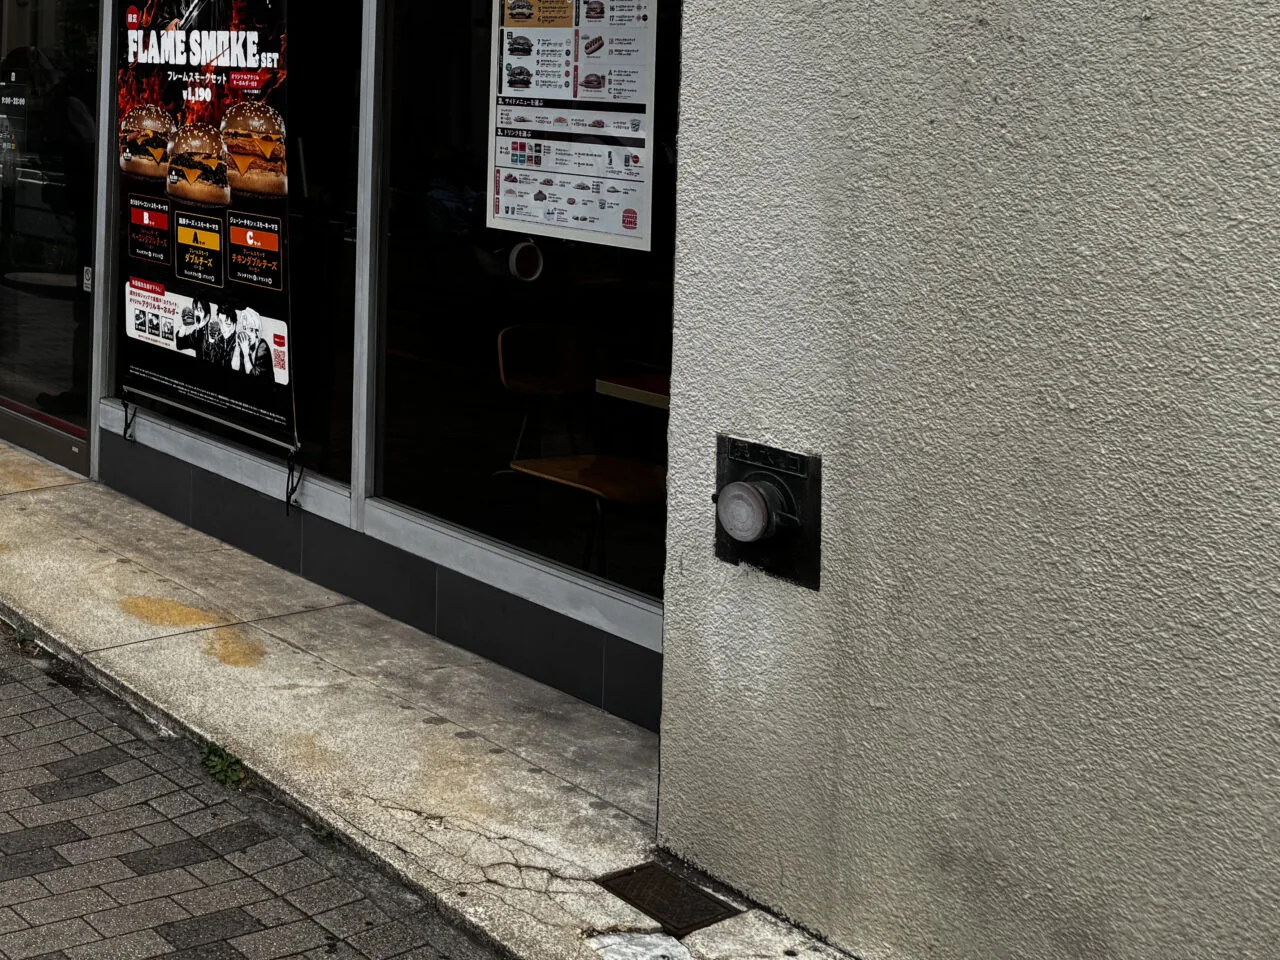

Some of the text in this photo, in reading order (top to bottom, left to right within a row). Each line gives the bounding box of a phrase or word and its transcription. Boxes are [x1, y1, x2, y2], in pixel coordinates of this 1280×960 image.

[127, 29, 280, 68] FLAME SMOKE SET
[167, 71, 227, 85] フレームスモークセット
[182, 86, 213, 103] ¥1,190
